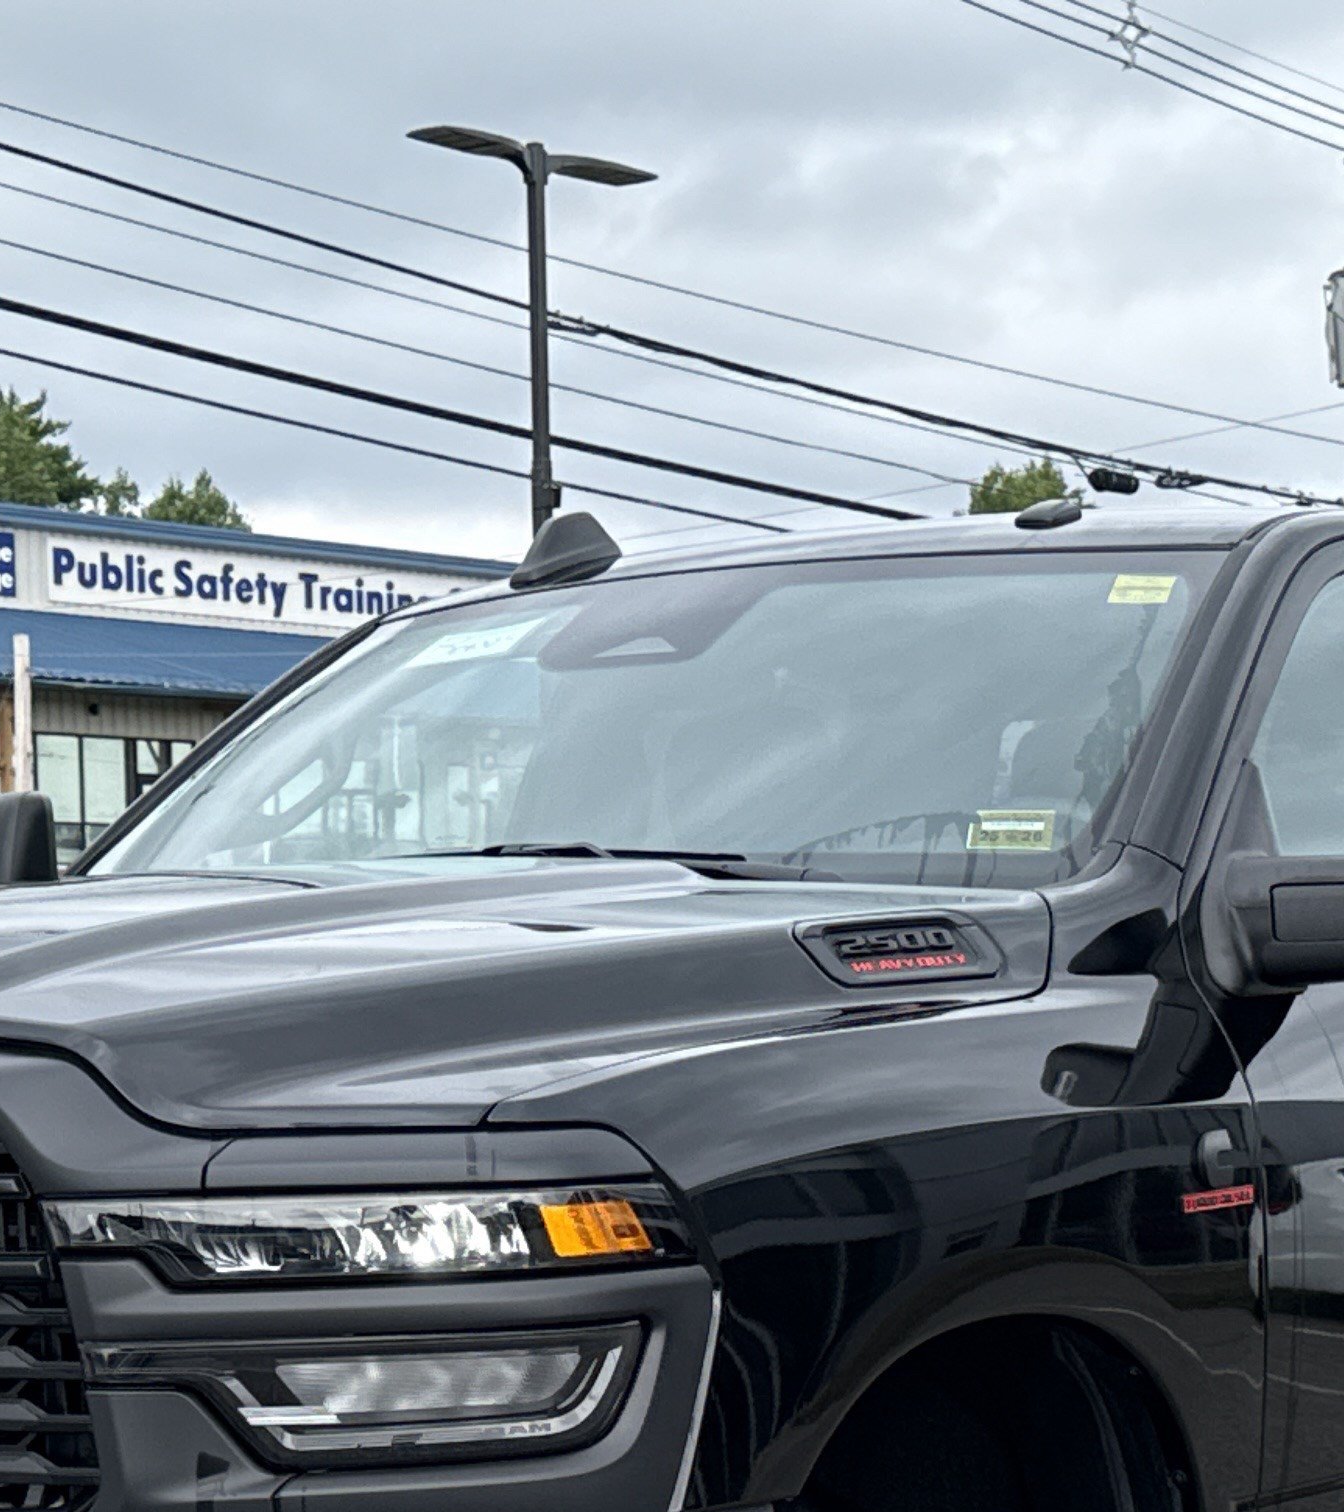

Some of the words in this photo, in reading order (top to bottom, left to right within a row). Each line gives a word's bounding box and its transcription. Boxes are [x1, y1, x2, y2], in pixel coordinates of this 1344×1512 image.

[52, 546, 165, 596] Public
[173, 558, 288, 618] Safety
[297, 572, 432, 617] Trainin
[835, 926, 956, 958] 2500
